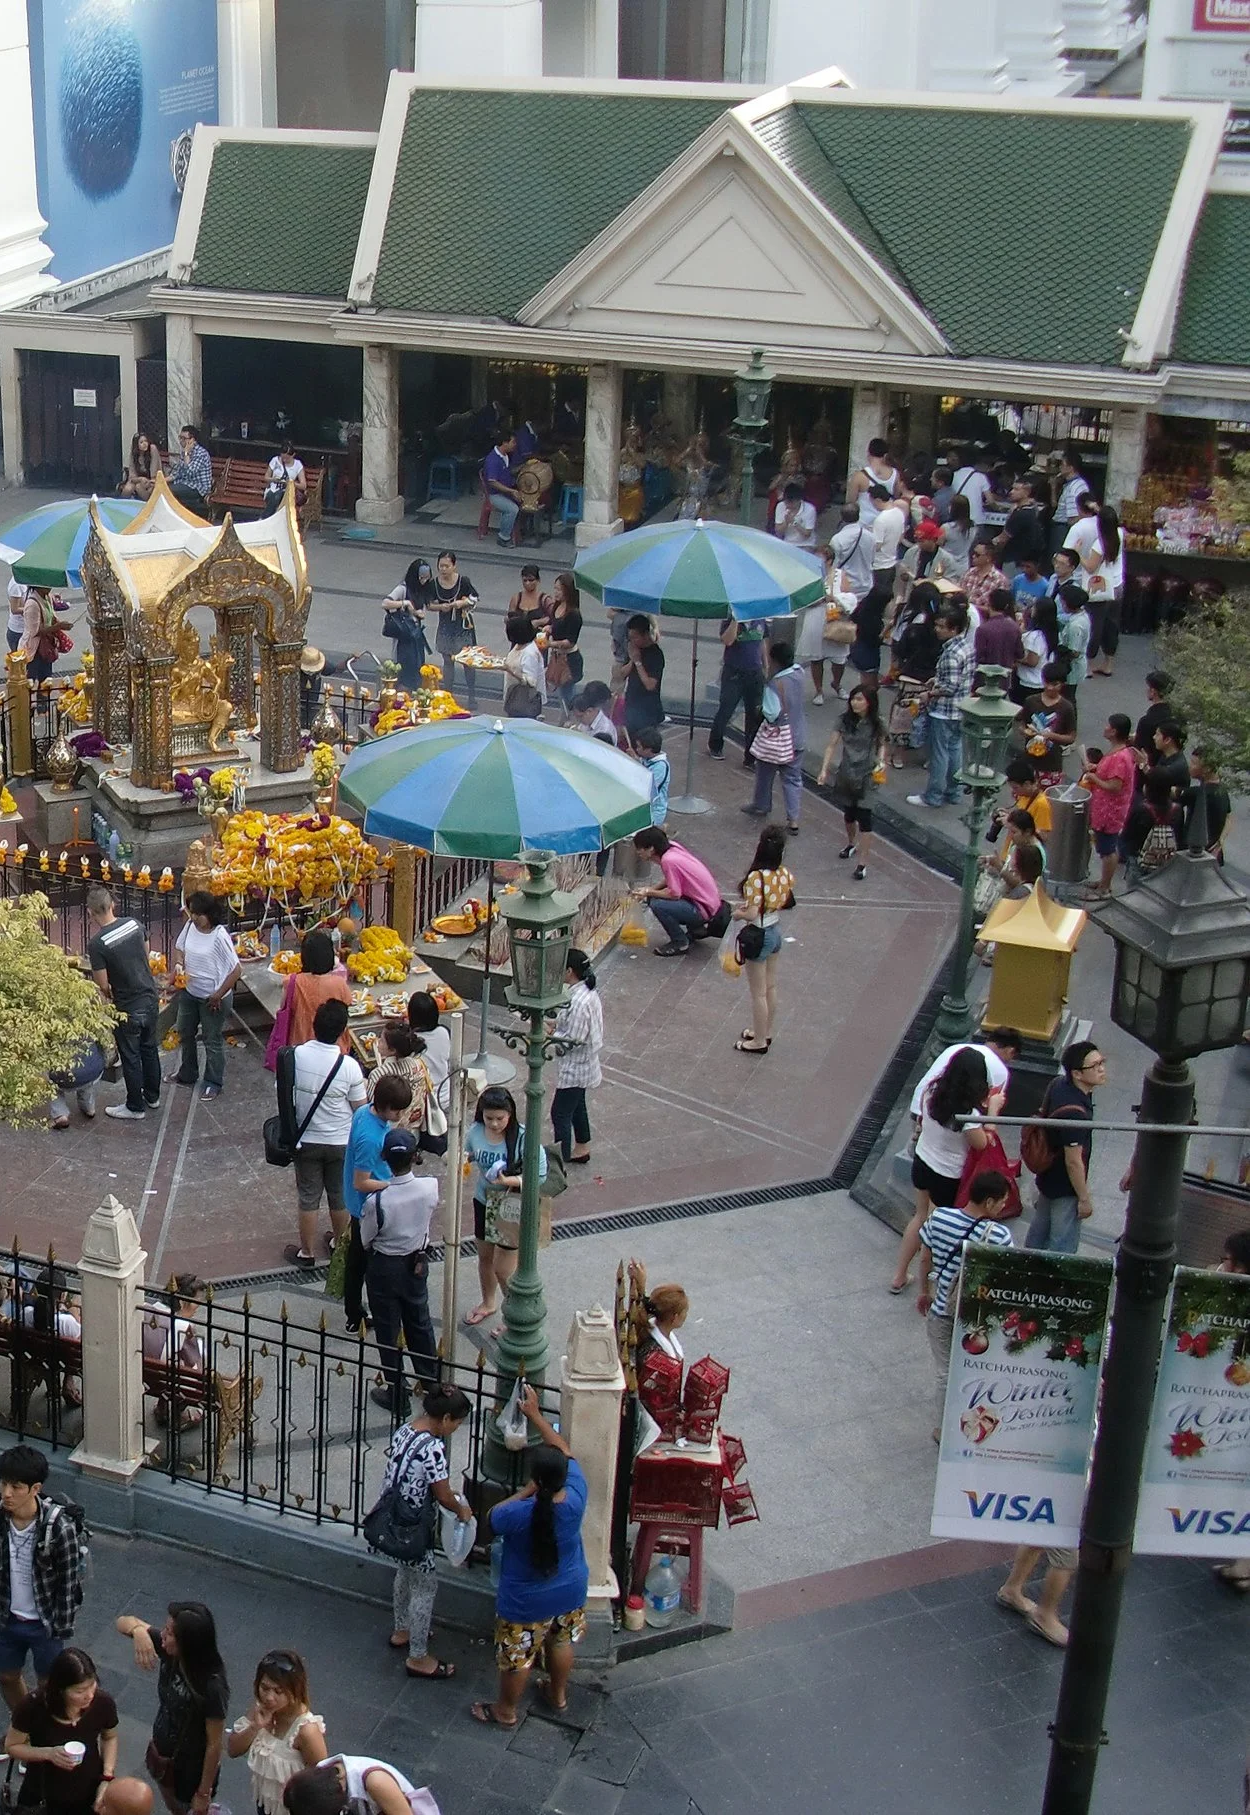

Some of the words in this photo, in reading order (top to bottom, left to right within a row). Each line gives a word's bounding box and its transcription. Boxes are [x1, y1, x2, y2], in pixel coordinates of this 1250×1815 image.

[977, 1285, 1092, 1310] RATCHAPRASONG
[963, 1359, 1068, 1380] RATCHAPRASONG
[961, 1378, 1072, 1409] Winter
[1001, 1404, 1075, 1423] Festival
[961, 1490, 1055, 1524] VISA
[1164, 1508, 1250, 1535] VISA
